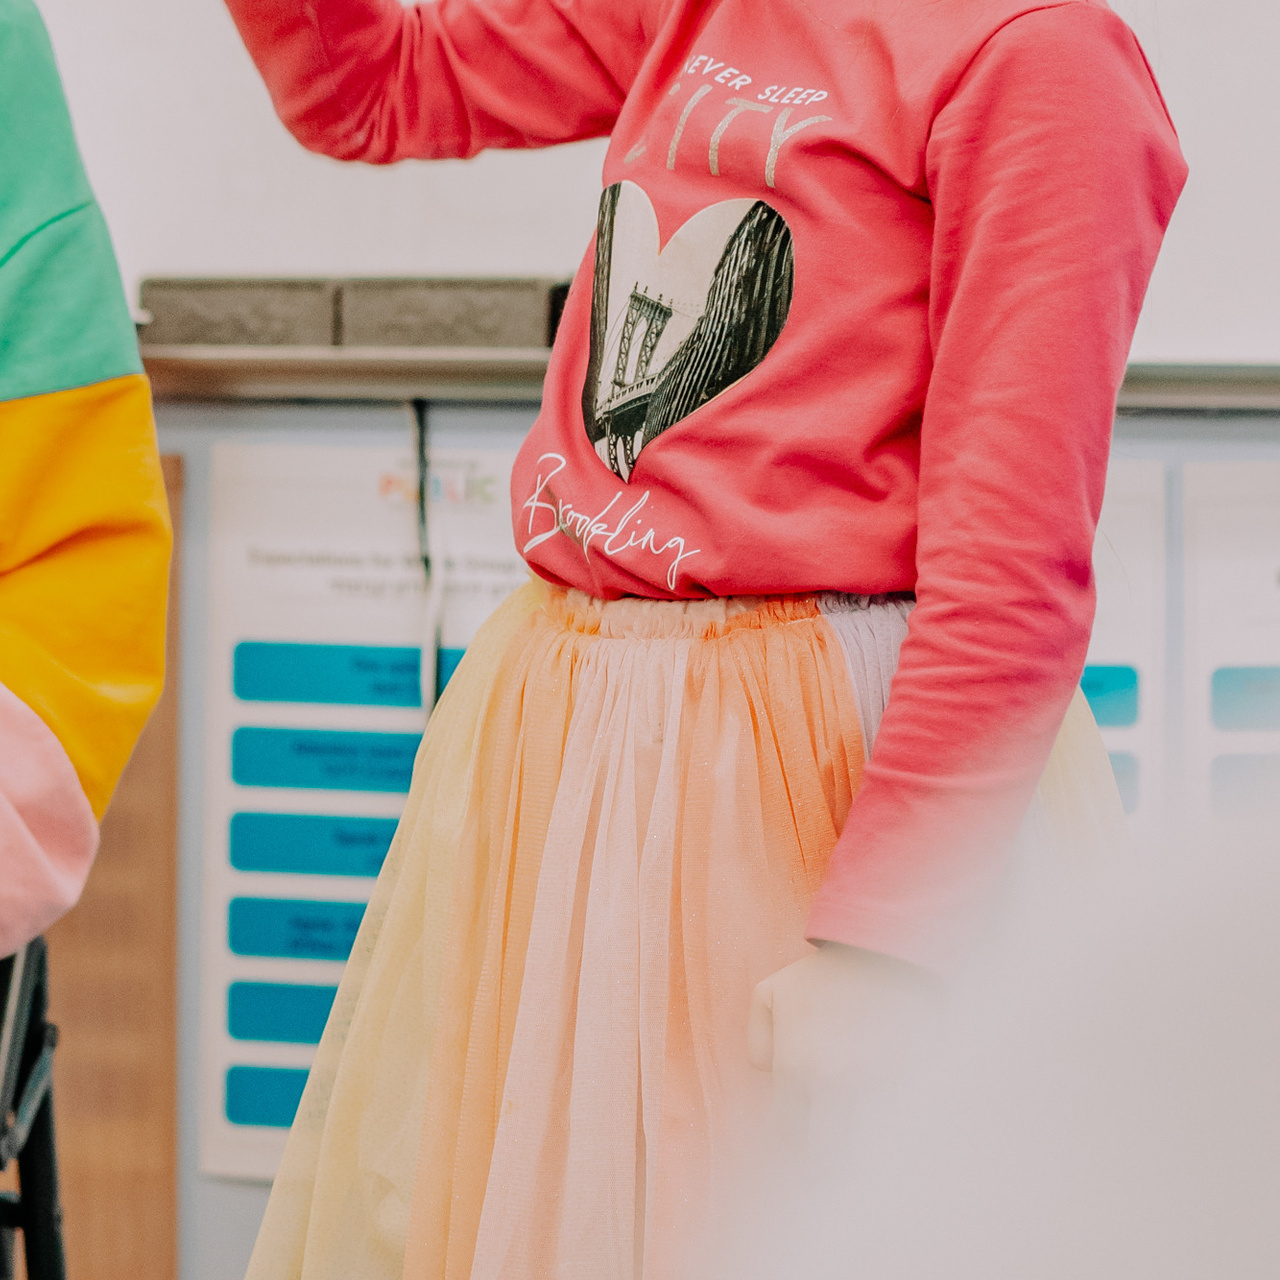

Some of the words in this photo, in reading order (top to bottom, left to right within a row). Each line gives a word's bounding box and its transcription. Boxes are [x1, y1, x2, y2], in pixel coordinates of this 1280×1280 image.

[623, 82, 833, 189] ITY
[757, 84, 829, 106] SLEEP
[523, 452, 701, 590] Brookling
